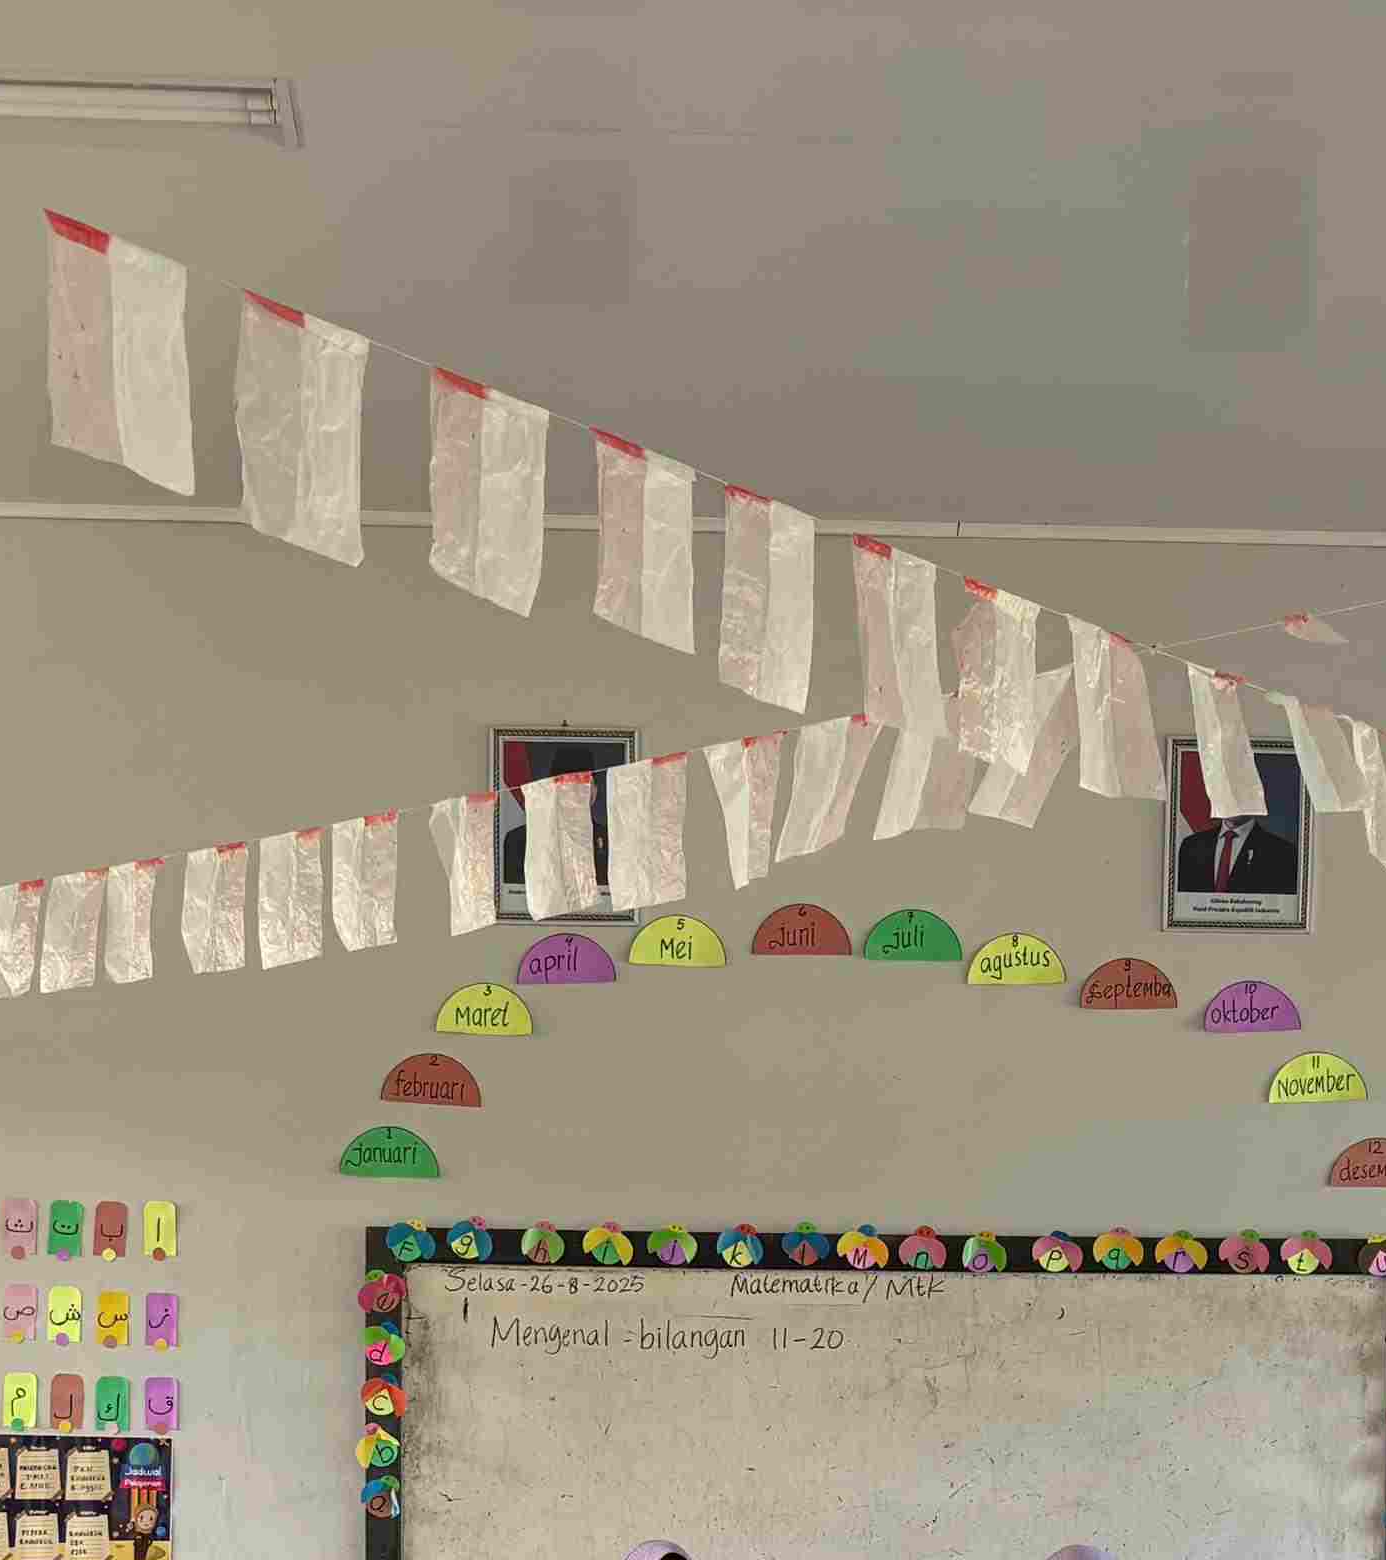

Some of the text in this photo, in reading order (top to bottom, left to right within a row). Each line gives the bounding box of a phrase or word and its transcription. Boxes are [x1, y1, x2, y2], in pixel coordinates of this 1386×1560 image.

[676, 918, 685, 931] 5
[768, 921, 816, 949] juni
[882, 926, 925, 953] juli
[1011, 934, 1019, 948] 8
[659, 935, 693, 961] Mei
[529, 946, 578, 984] april
[979, 947, 1051, 980] agustus
[483, 985, 493, 997] 3
[1244, 983, 1257, 994] 10
[455, 1001, 510, 1028] Maret
[1211, 996, 1279, 1024] oktober
[429, 1056, 440, 1066] 2
[1311, 1055, 1321, 1068] 11
[394, 1069, 465, 1100] februari
[1277, 1072, 1356, 1099] November
[386, 1127, 393, 1140] 1
[344, 1142, 418, 1168] januari
[1367, 1140, 1384, 1154] 12
[4, 1218, 34, 1233] ث
[52, 1222, 79, 1236] ت
[100, 1223, 124, 1242] ب
[460, 1235, 472, 1256] g
[914, 1252, 928, 1268] n
[885, 1276, 946, 1300] Mtk
[3, 1306, 35, 1321] ص
[49, 1303, 81, 1326] ش
[97, 1311, 130, 1328] س
[491, 1316, 610, 1355] Mengenal
[771, 1326, 845, 1350] 11-20
[370, 1343, 388, 1361] d
[11, 1387, 27, 1417] م
[53, 1393, 74, 1420] ل
[148, 1396, 175, 1416] ق
[377, 1443, 395, 1464] b
[125, 1466, 163, 1476] Jadwal
